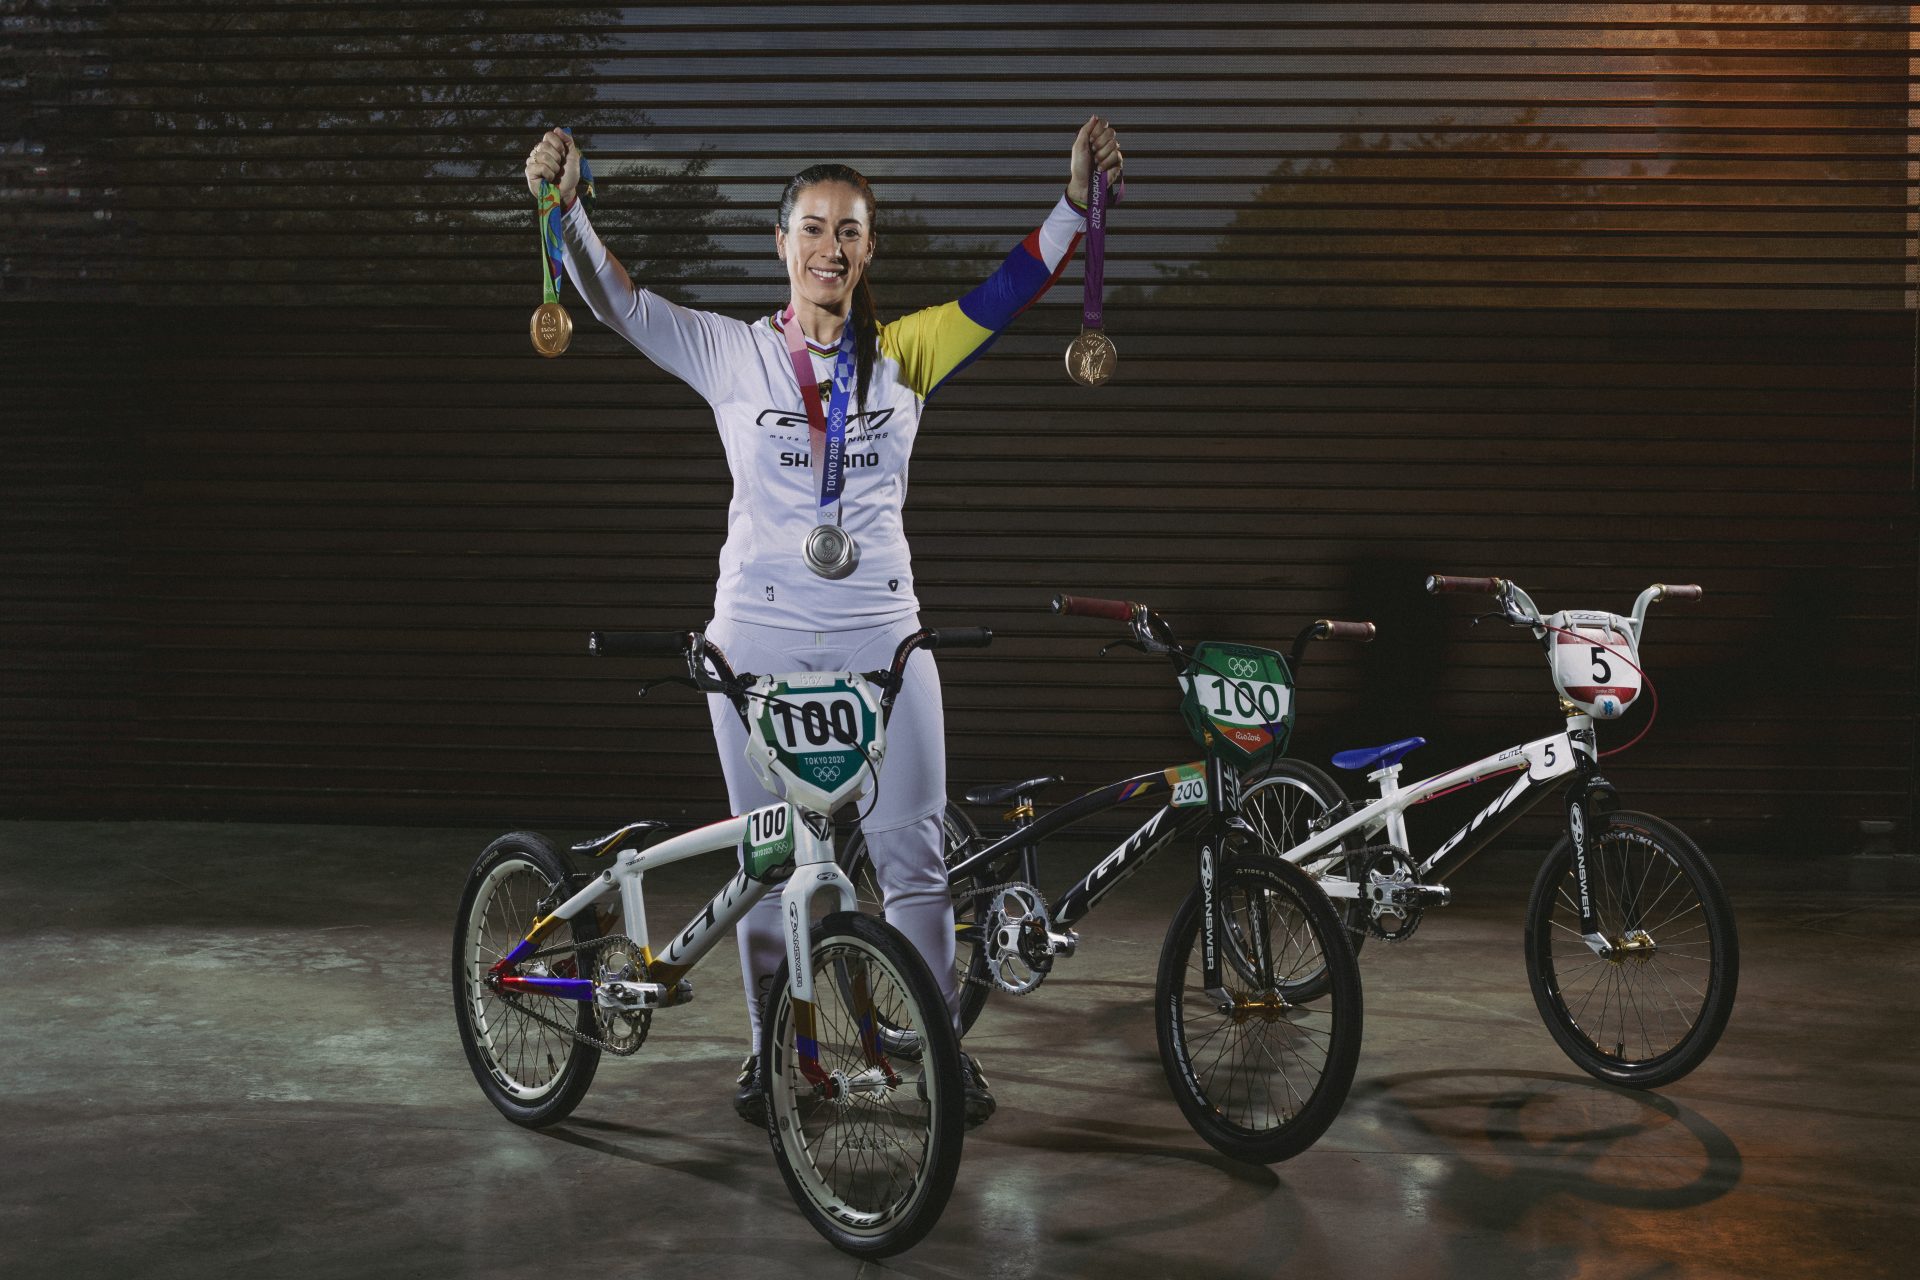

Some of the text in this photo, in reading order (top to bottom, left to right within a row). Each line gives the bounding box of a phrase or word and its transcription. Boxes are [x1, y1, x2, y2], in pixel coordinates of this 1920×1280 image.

[1092, 207, 1101, 230] 2012
[780, 452, 879, 468] SHANO
[827, 436, 840, 492] TOKYO 2020
[1591, 647, 1611, 684] 5
[1211, 678, 1280, 722] 100
[773, 699, 858, 747] 100
[804, 755, 845, 765] TOKYO 2020
[1543, 743, 1556, 768] 5
[1175, 780, 1204, 801] 100
[752, 806, 786, 842] 100
[1577, 844, 1591, 919] ANSWER
[1204, 890, 1215, 971] ANSWER
[793, 930, 803, 988] ANSWER
